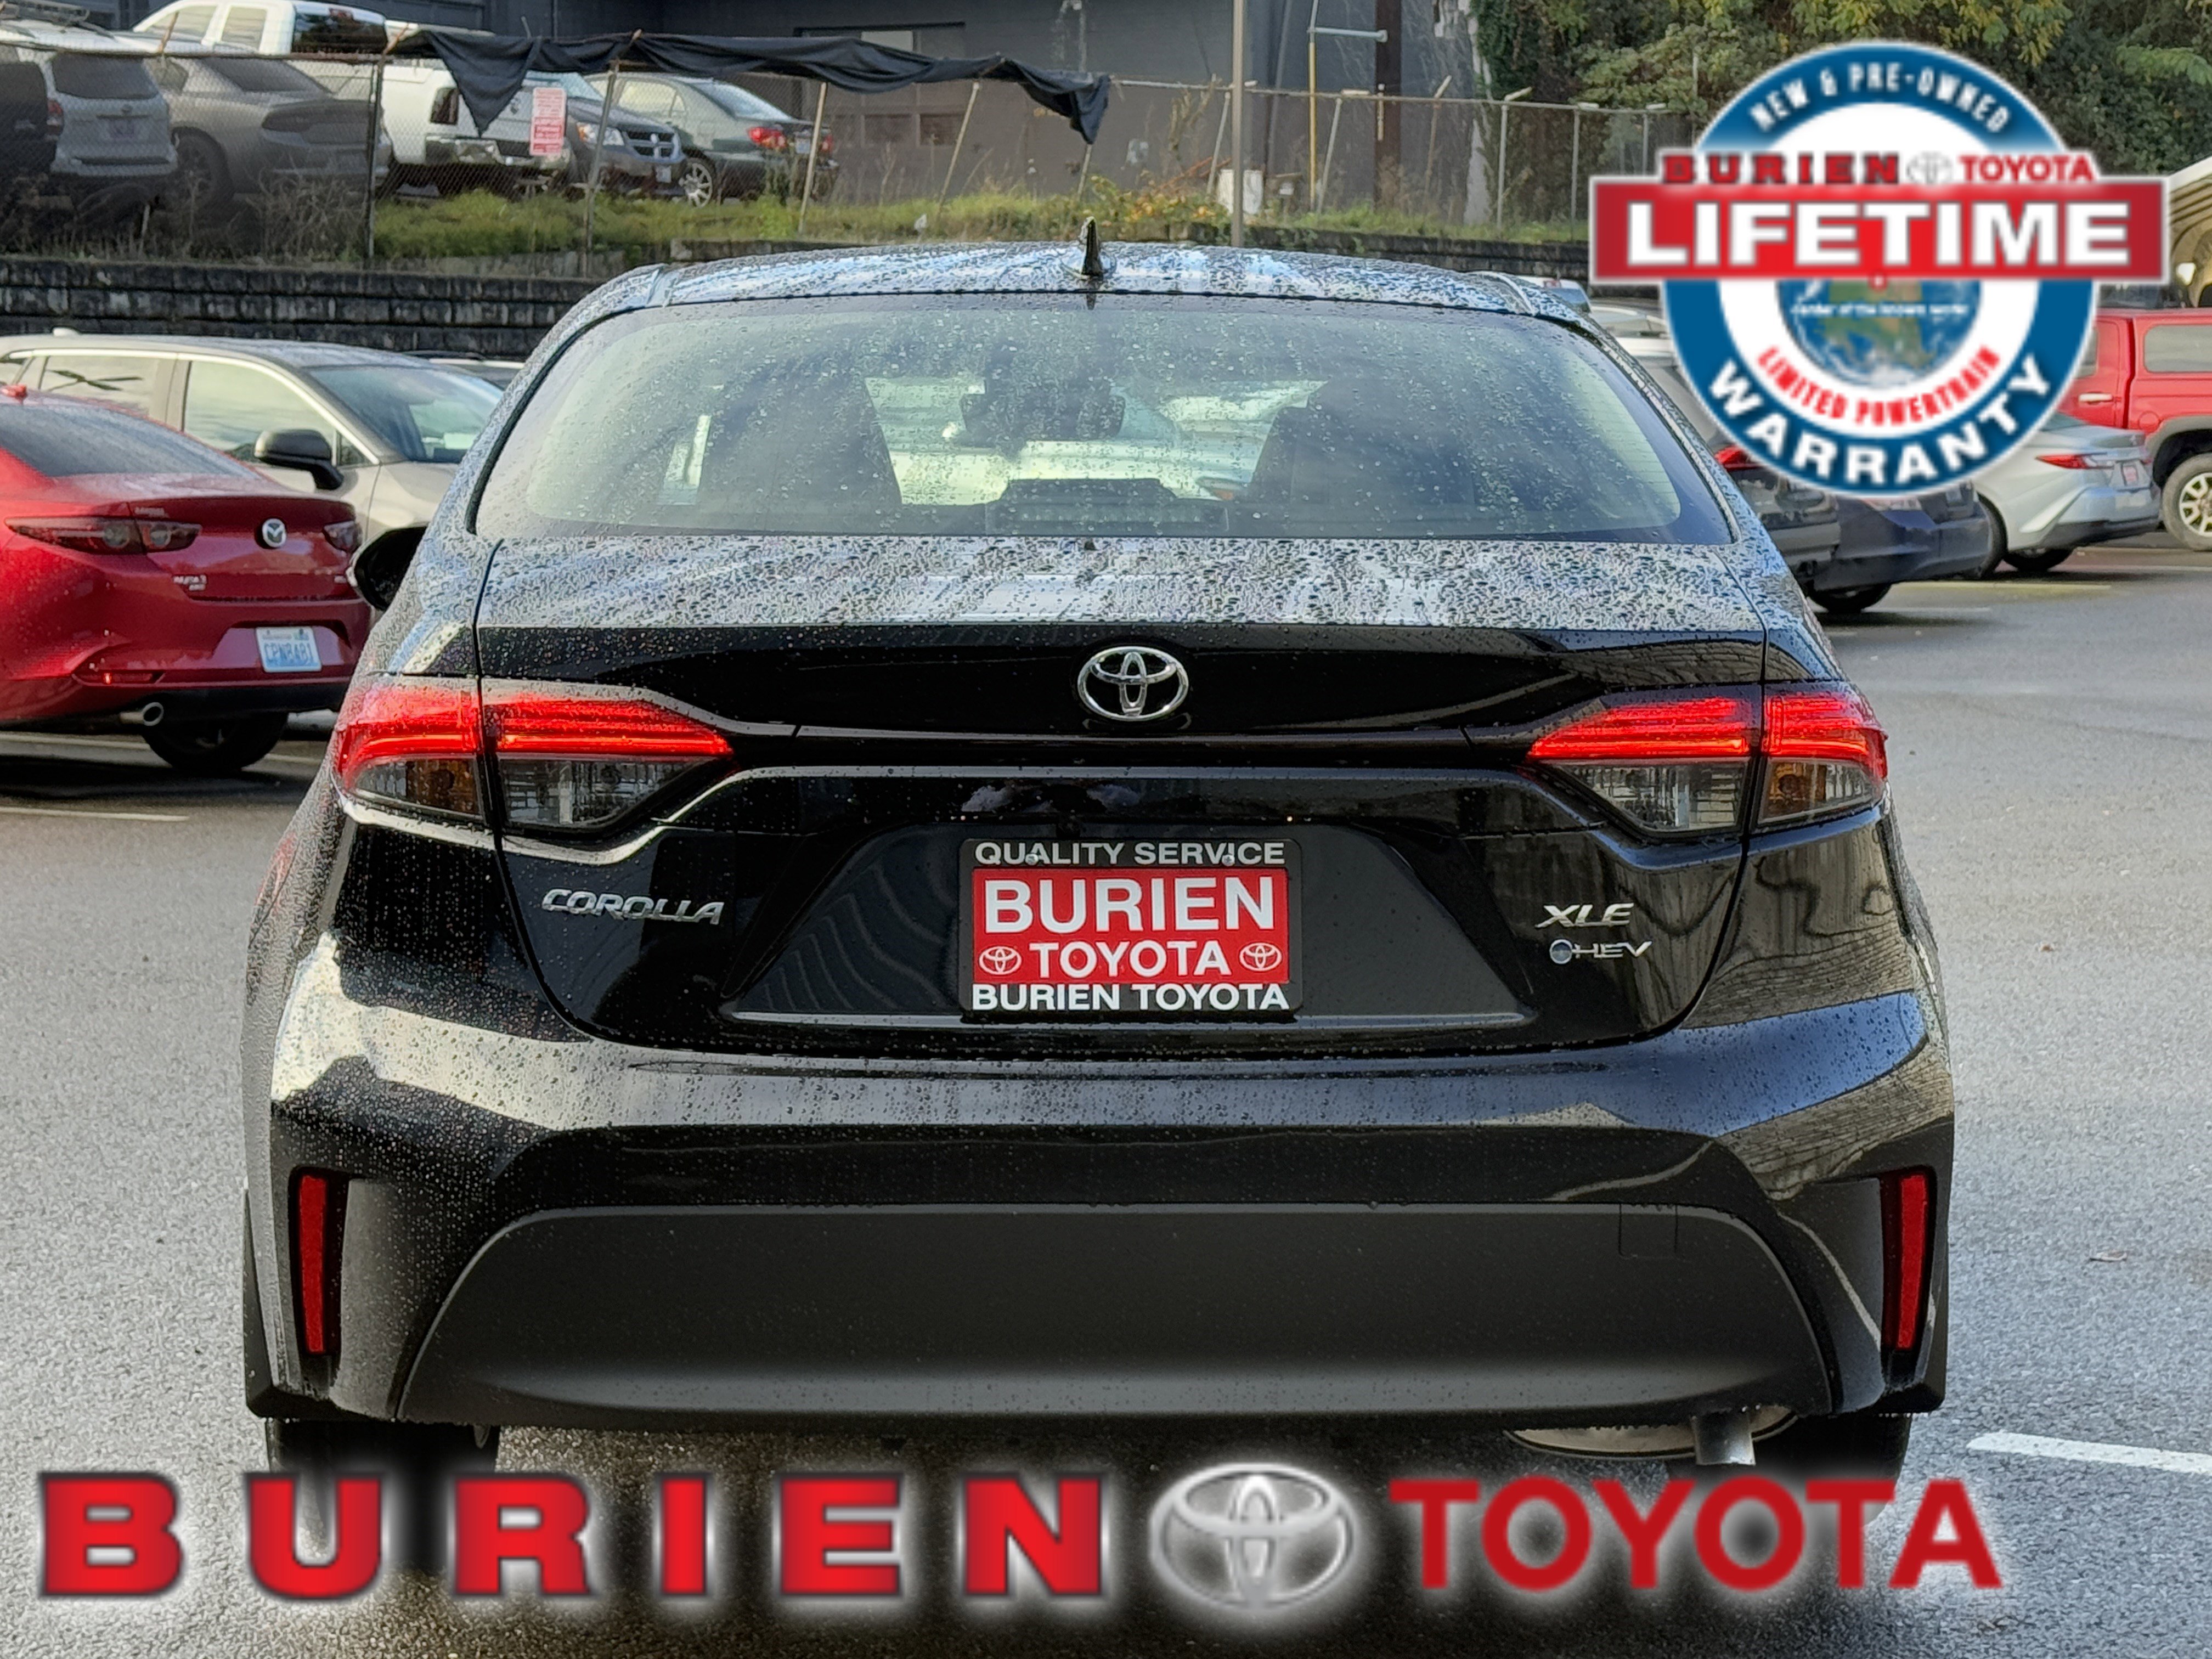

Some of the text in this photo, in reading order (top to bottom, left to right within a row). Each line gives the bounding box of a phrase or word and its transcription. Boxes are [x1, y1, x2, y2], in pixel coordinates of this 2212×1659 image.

[975, 842, 1285, 865] QUALITY SERVICE
[541, 889, 725, 925] COROLLA
[984, 876, 1274, 934] BURIEN
[1535, 902, 1634, 927] XLE
[1029, 940, 1232, 979] TOYOTA
[1572, 940, 1652, 958] HEV
[972, 983, 1290, 1011] BURIEN TOYOTA
